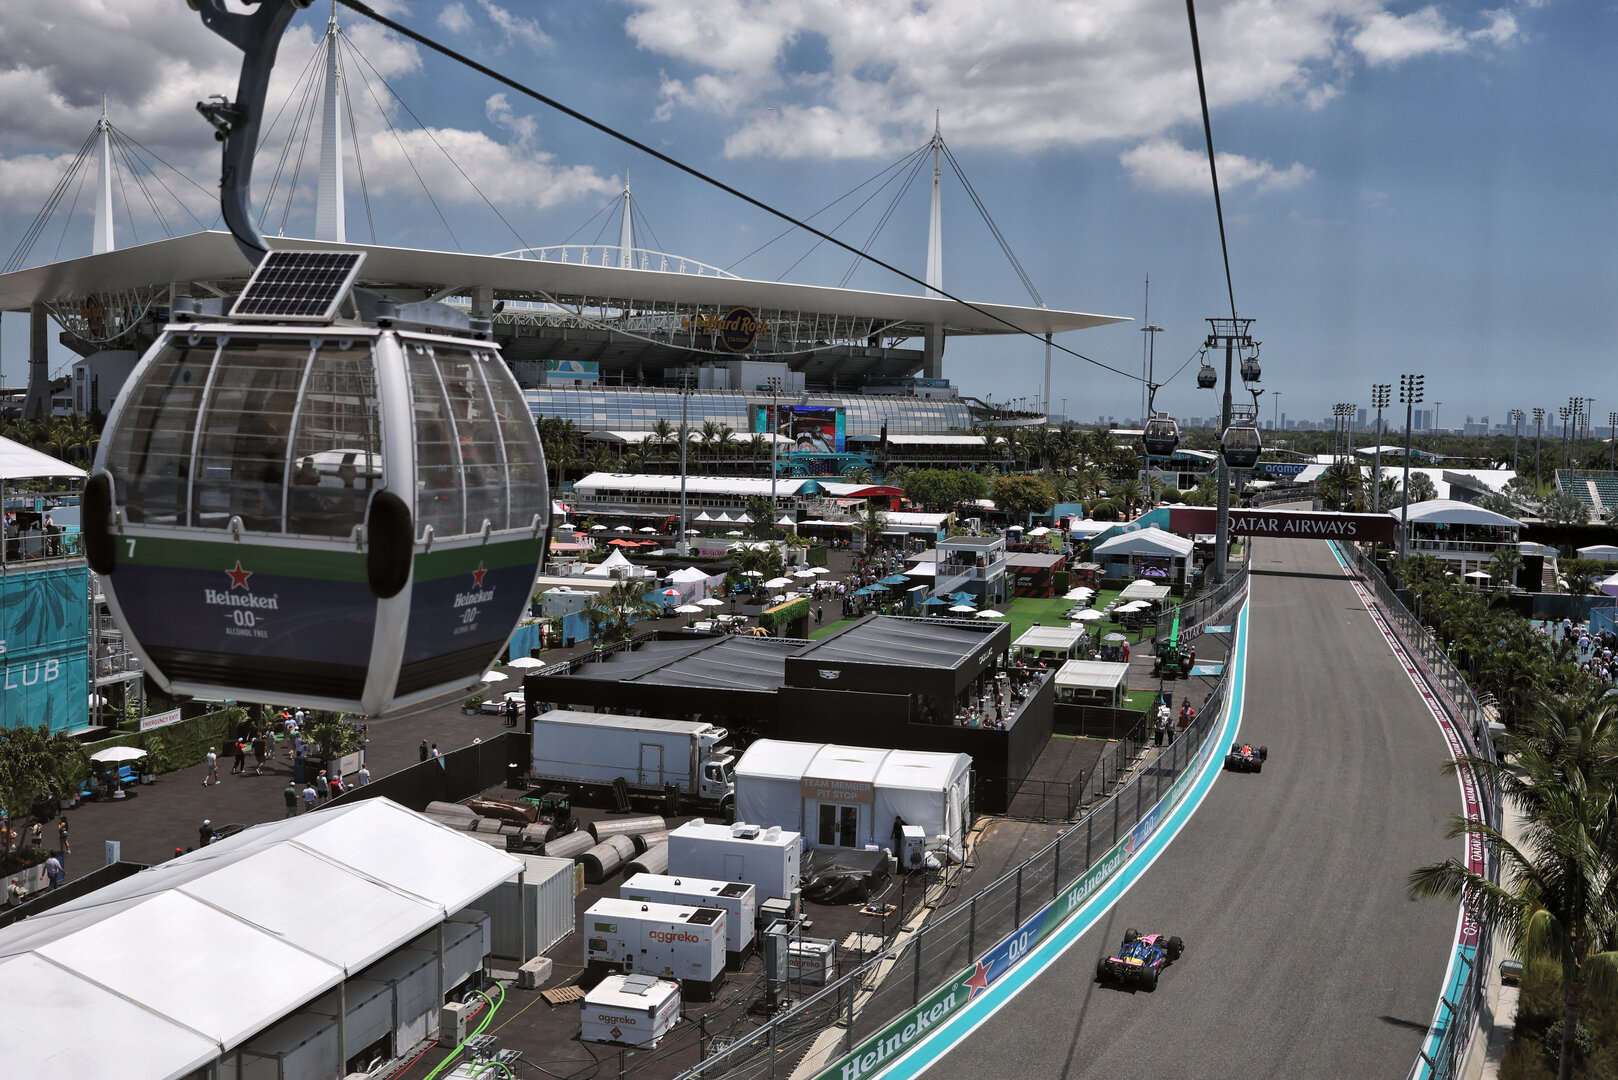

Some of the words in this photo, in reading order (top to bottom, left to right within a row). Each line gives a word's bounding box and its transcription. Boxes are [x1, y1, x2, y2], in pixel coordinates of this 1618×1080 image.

[710, 314, 740, 332] Hard
[740, 316, 769, 336] Rock
[1265, 464, 1304, 474] aramco
[1228, 517, 1279, 532] QATAR
[1283, 518, 1357, 535] AIRWAYS
[126, 539, 136, 558] 7
[204, 588, 279, 610] Heineken
[454, 590, 493, 607] Heineken
[142, 716, 168, 728] EMERGENCY
[169, 713, 179, 722] EXIT
[804, 779, 829, 787] TEAM
[832, 782, 870, 791] MEMBER
[833, 791, 857, 799] STOP
[1471, 837, 1483, 861] QATAR
[1067, 853, 1121, 912] Heineken
[649, 929, 700, 944] aggreko
[598, 1013, 636, 1026] aggreko
[841, 991, 957, 1080] Heineken
